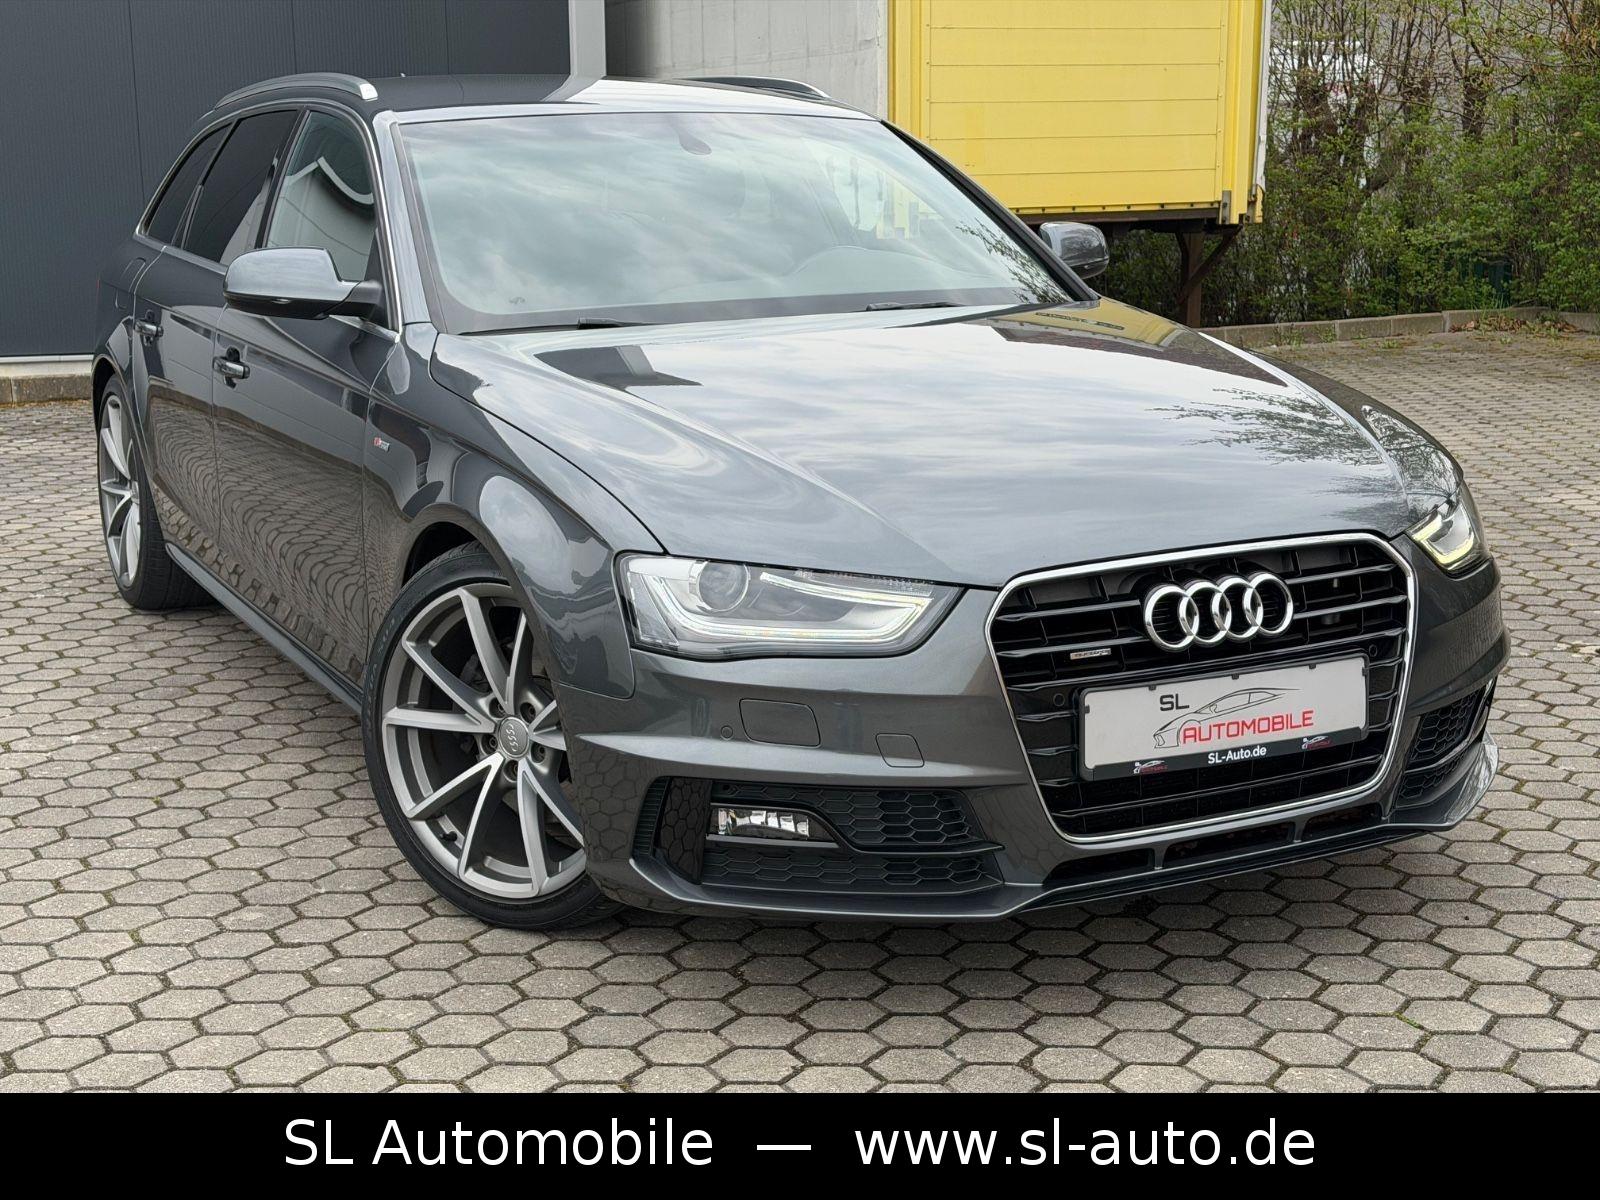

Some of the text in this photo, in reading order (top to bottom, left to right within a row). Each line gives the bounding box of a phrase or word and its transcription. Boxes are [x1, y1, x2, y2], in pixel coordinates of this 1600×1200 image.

[1159, 693, 1190, 712] SL
[1182, 710, 1315, 744] AUTOMOBILE
[1207, 745, 1267, 764] SL-Auto.de
